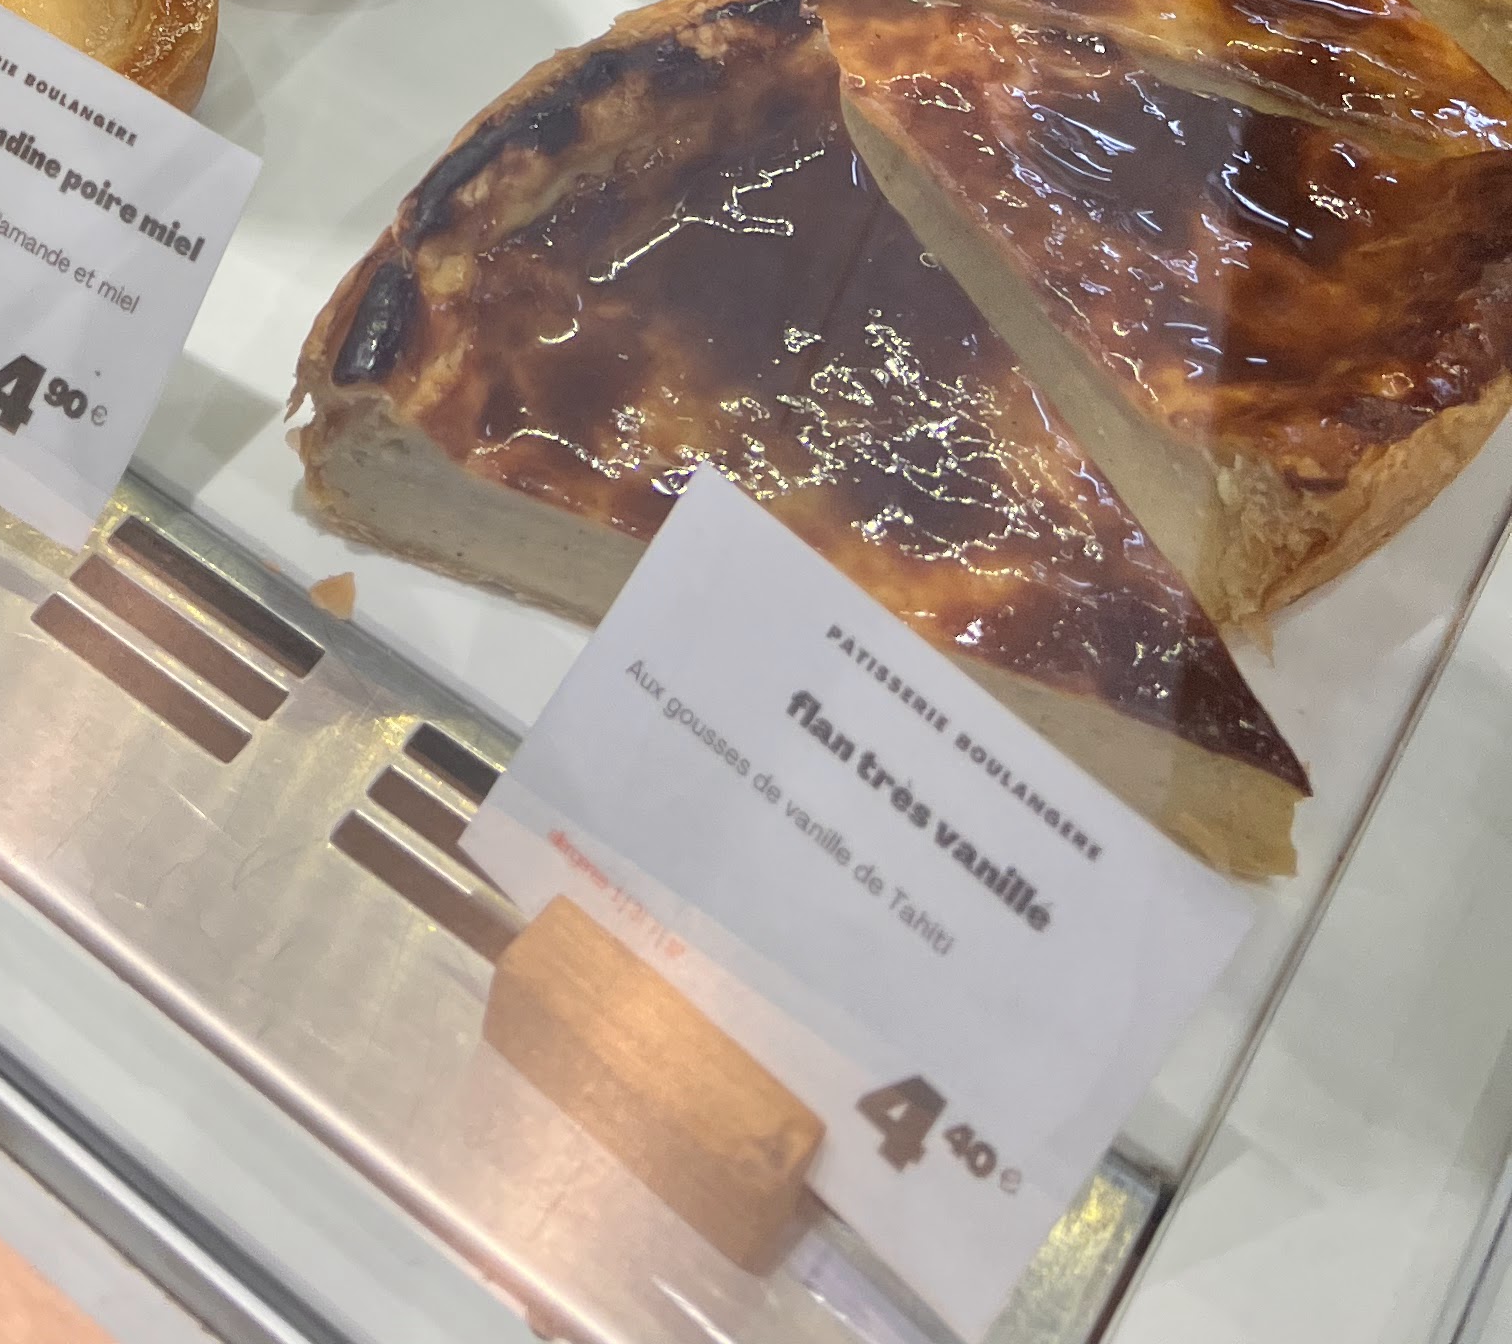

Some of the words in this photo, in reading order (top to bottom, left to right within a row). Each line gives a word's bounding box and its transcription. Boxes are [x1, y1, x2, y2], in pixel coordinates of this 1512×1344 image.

[59, 169, 138, 224] poire
[138, 214, 205, 262] miel
[74, 267, 95, 288] et
[97, 281, 140, 314] miel
[626, 660, 665, 701] Aux
[663, 697, 750, 777] gousses
[753, 773, 781, 804] de
[785, 800, 852, 867] vanille
[853, 864, 884, 896] de
[889, 887, 955, 957] Tahiti
[786, 690, 855, 762] flan
[857, 751, 931, 829] très
